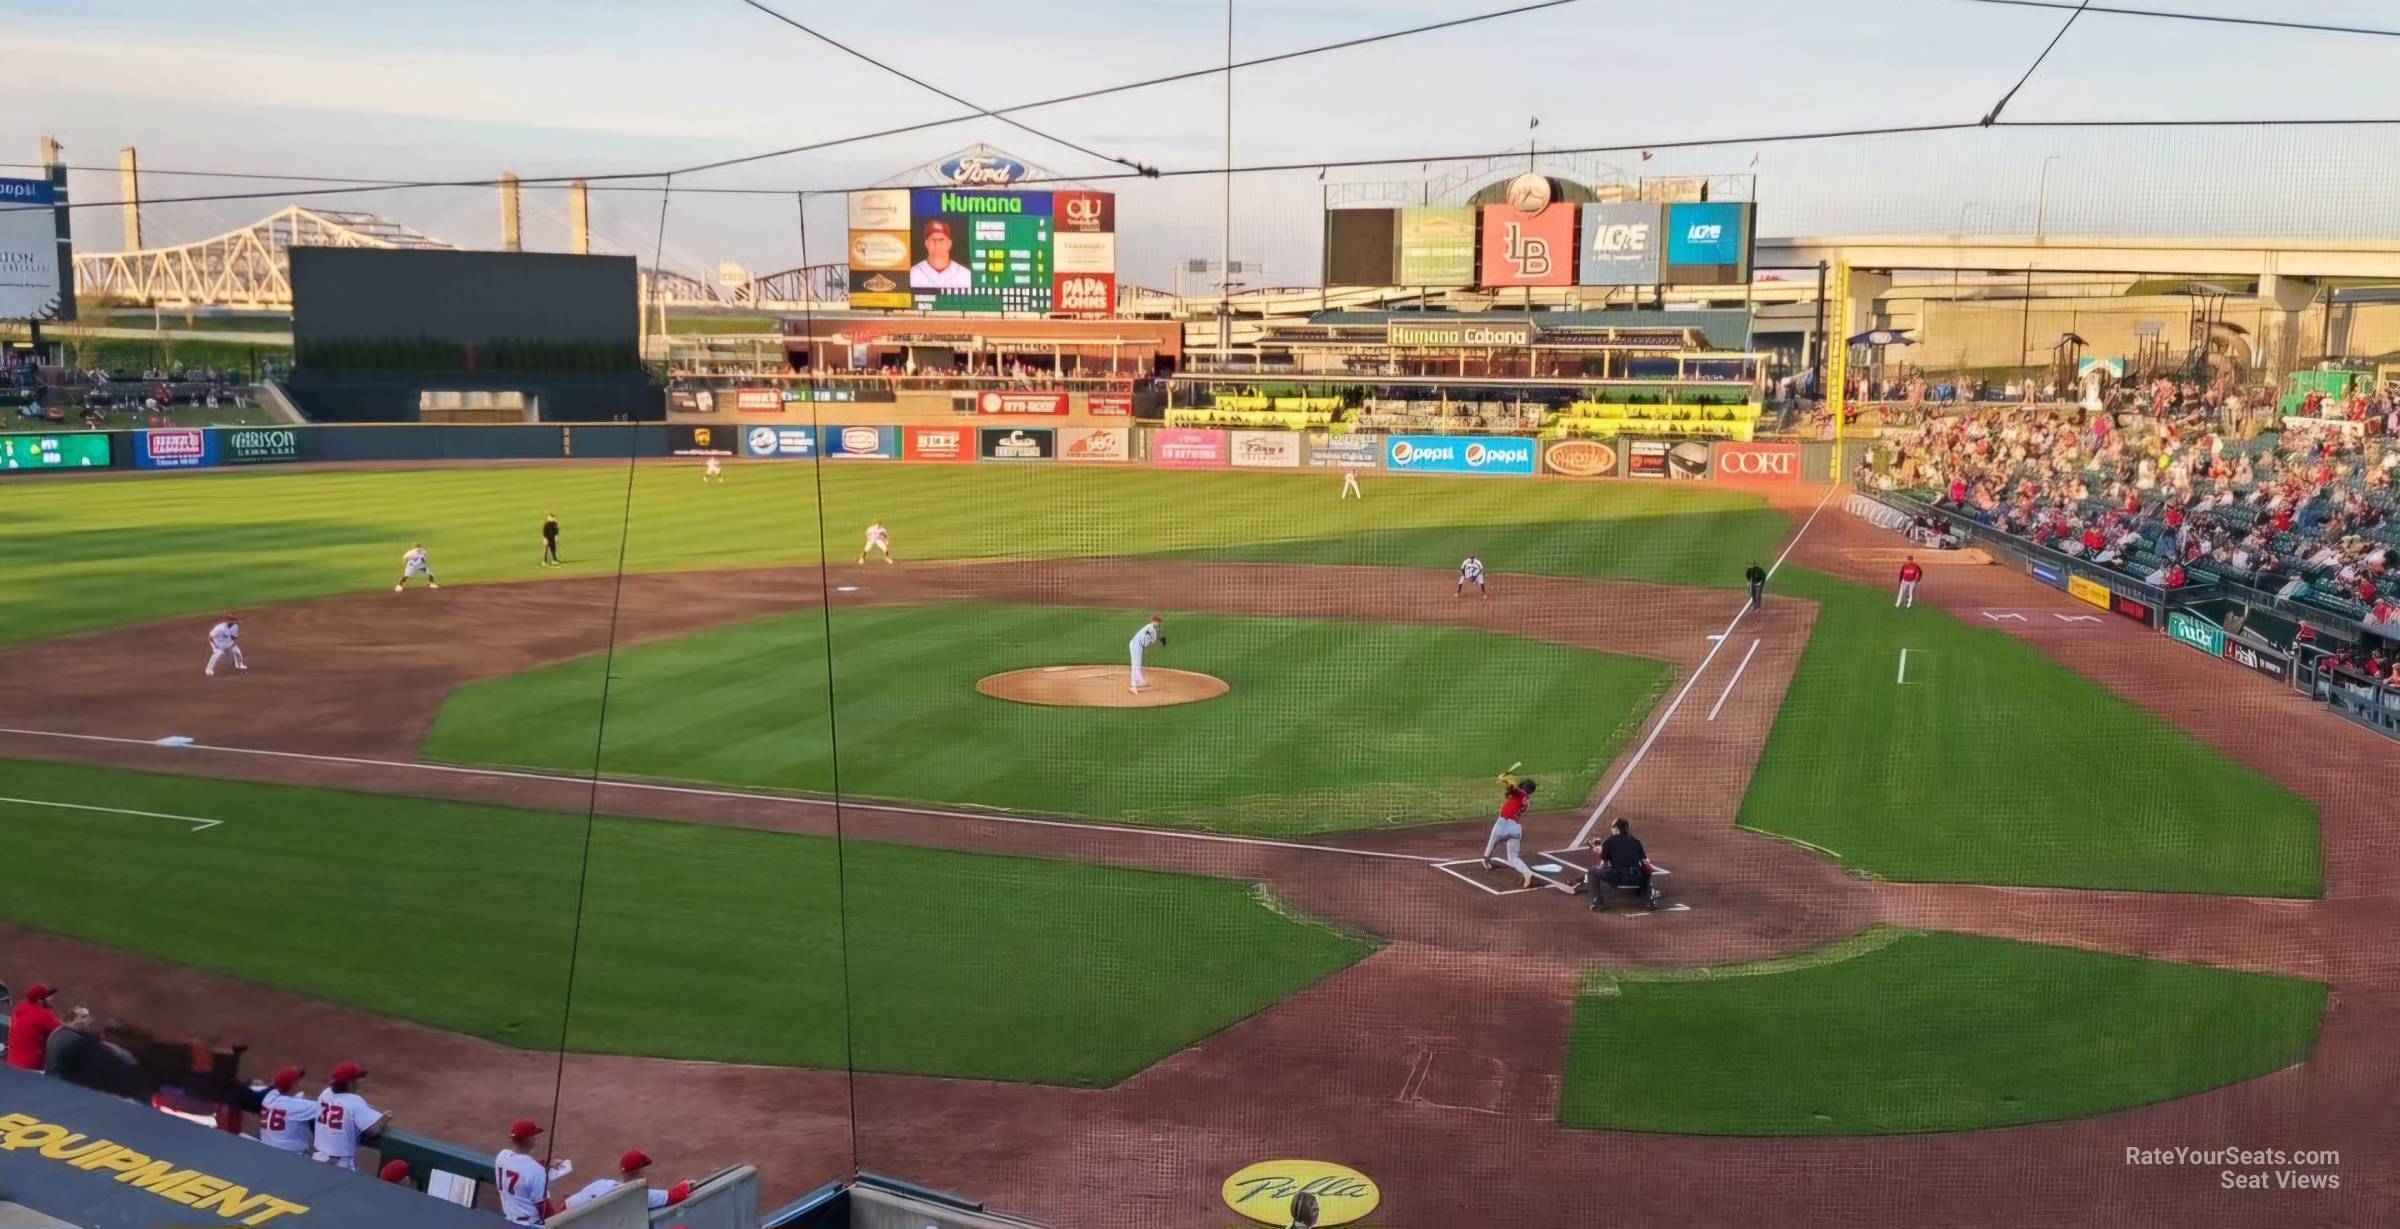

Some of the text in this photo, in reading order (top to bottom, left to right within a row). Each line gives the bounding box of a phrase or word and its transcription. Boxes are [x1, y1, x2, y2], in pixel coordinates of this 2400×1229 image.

[953, 156, 1010, 185] Ford
[941, 192, 1022, 213] Humana
[1061, 277, 1107, 297] PAPA
[1391, 326, 1527, 346] Humana Cabana
[1720, 450, 1797, 475] CORT
[318, 1101, 345, 1130] 32
[0, 1112, 311, 1227] EQUIPMENT
[497, 1166, 521, 1196] 17
